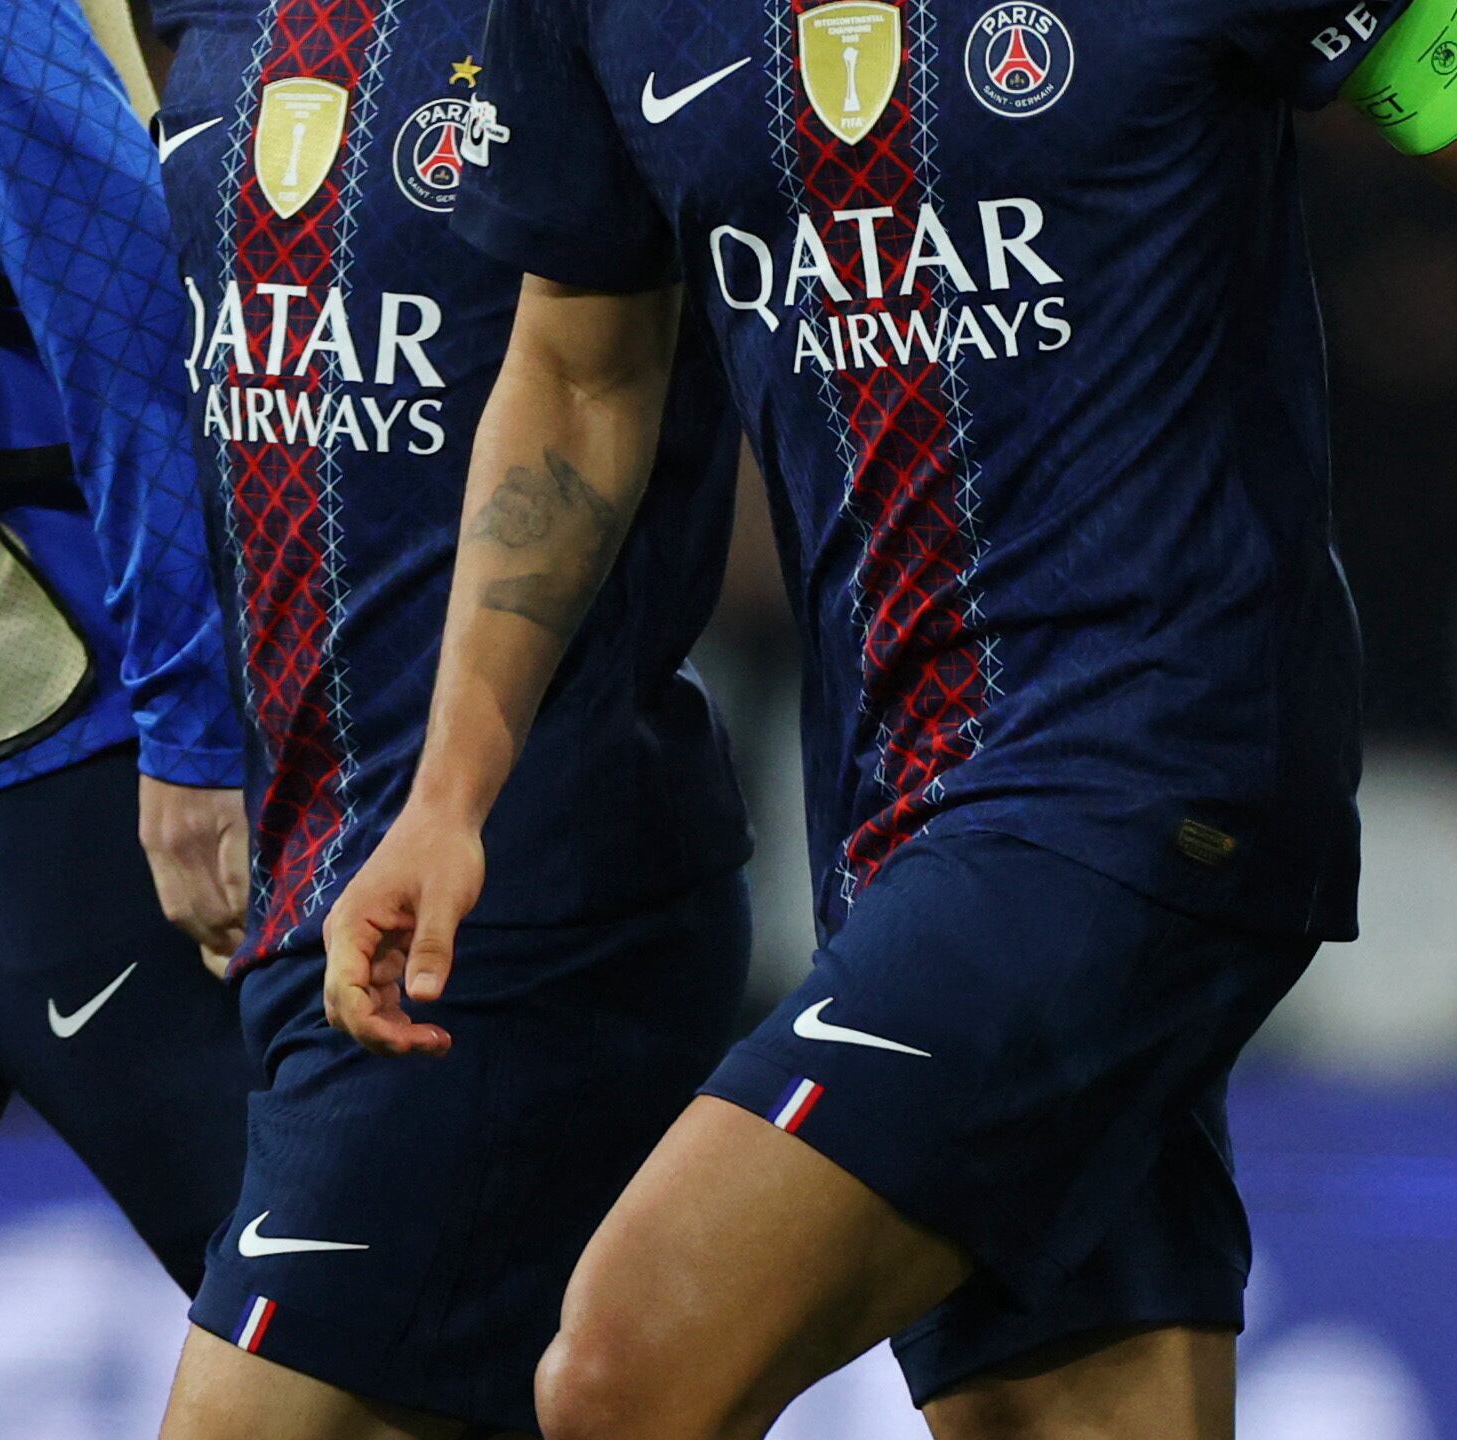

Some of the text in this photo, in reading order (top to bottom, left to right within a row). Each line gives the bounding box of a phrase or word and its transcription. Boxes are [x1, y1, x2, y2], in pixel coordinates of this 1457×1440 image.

[981, 6, 1053, 36] PARIS
[983, 82, 1055, 108] SAINT GERMAIN
[708, 196, 1064, 332] QATAR
[793, 296, 1072, 374] AIRWAYS
[203, 386, 445, 455] AIRWAYS
